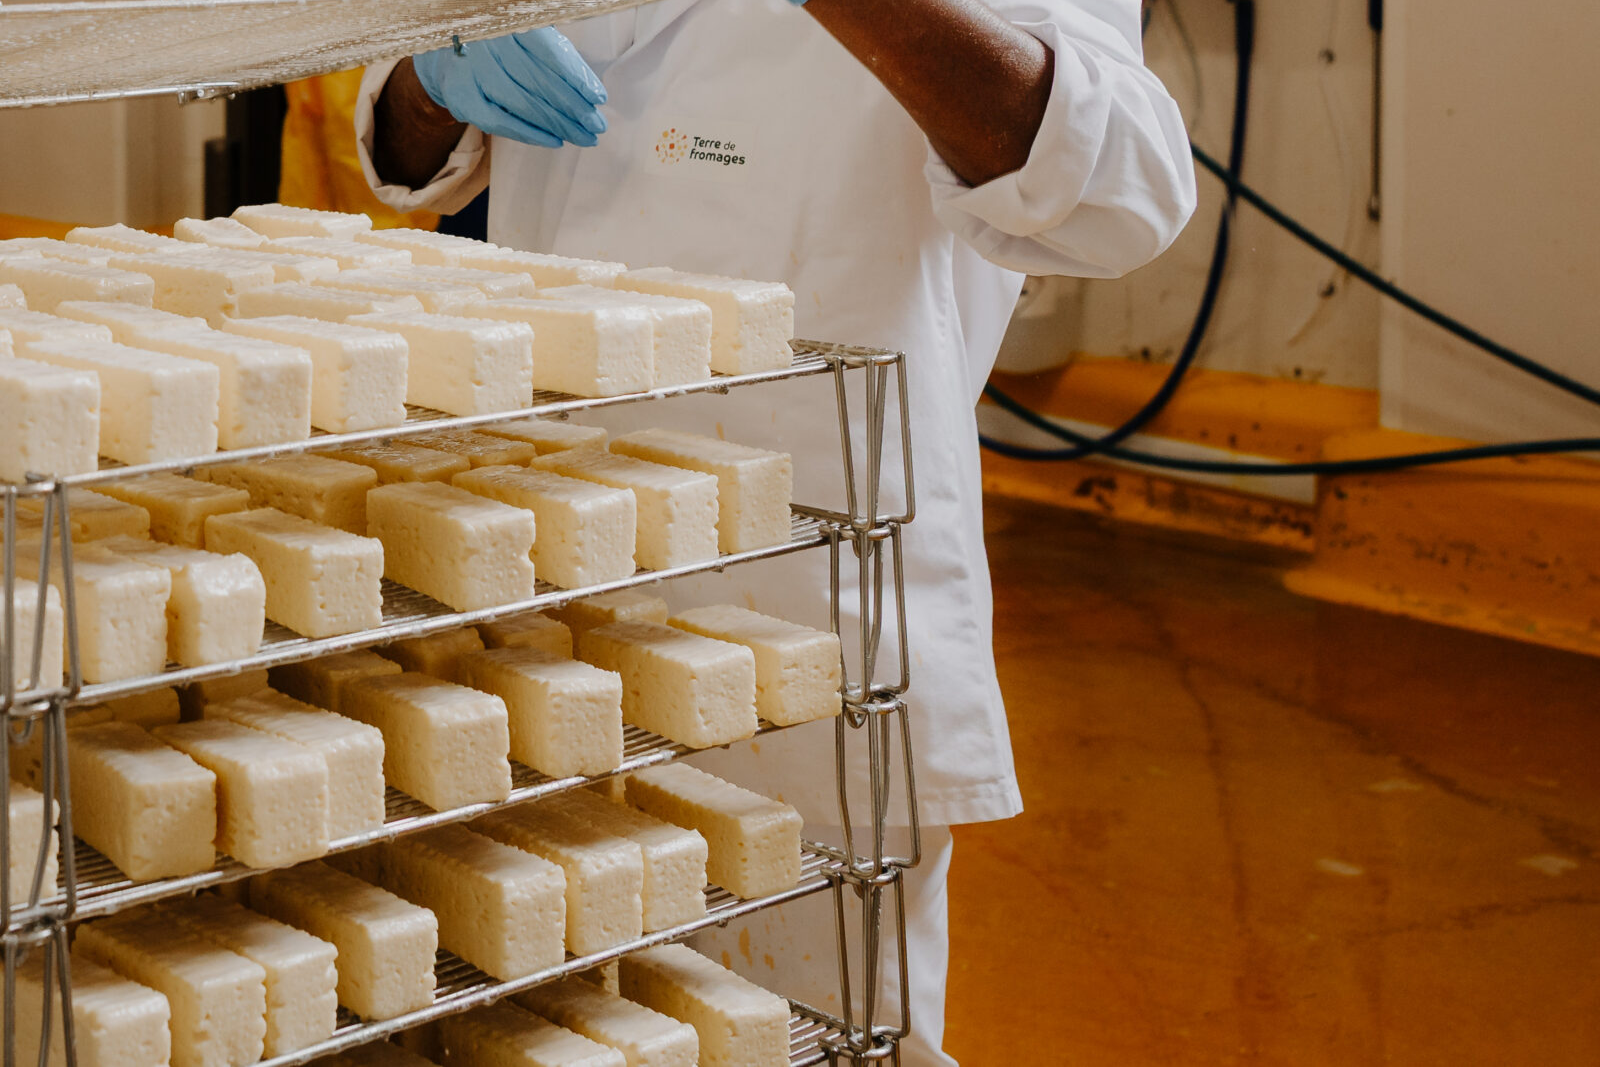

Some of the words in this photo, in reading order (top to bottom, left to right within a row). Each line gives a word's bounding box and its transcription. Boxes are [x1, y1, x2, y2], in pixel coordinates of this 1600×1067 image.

[693, 137, 721, 148] Terre
[723, 141, 736, 151] de
[690, 148, 746, 165] fromages
